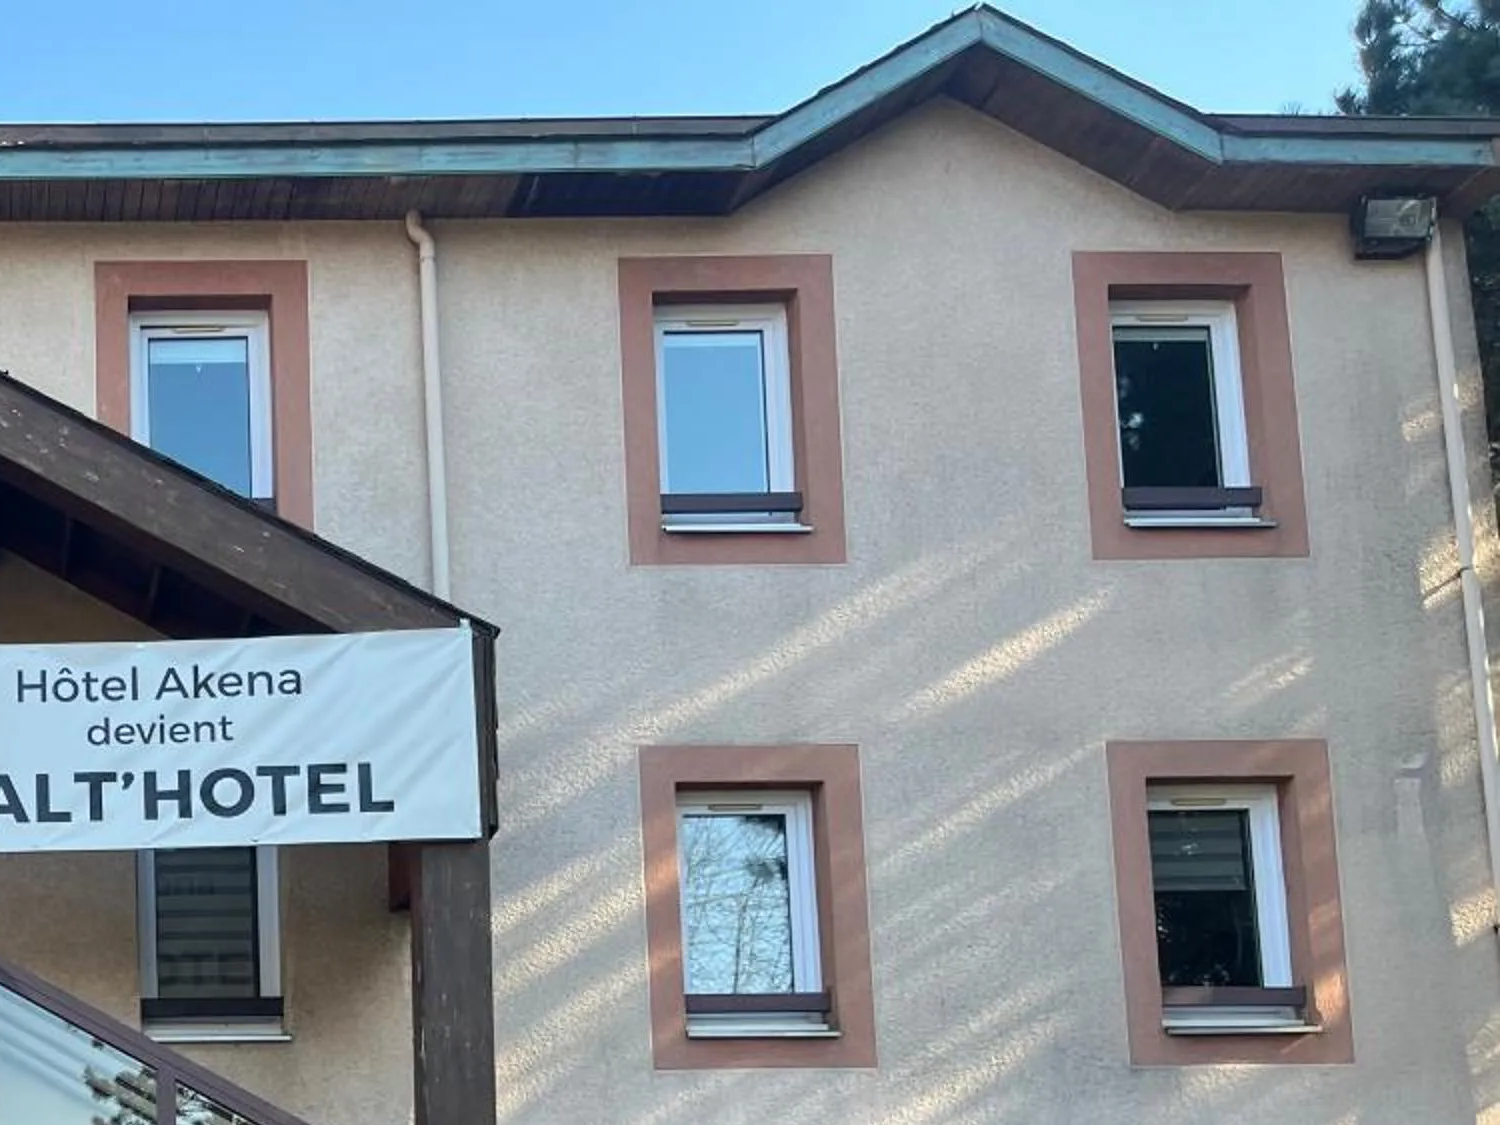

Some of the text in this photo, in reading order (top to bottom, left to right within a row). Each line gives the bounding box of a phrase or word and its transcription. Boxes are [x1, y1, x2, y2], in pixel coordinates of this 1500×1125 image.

[16, 664, 302, 703] Hôtel Akena
[86, 714, 235, 746] devient
